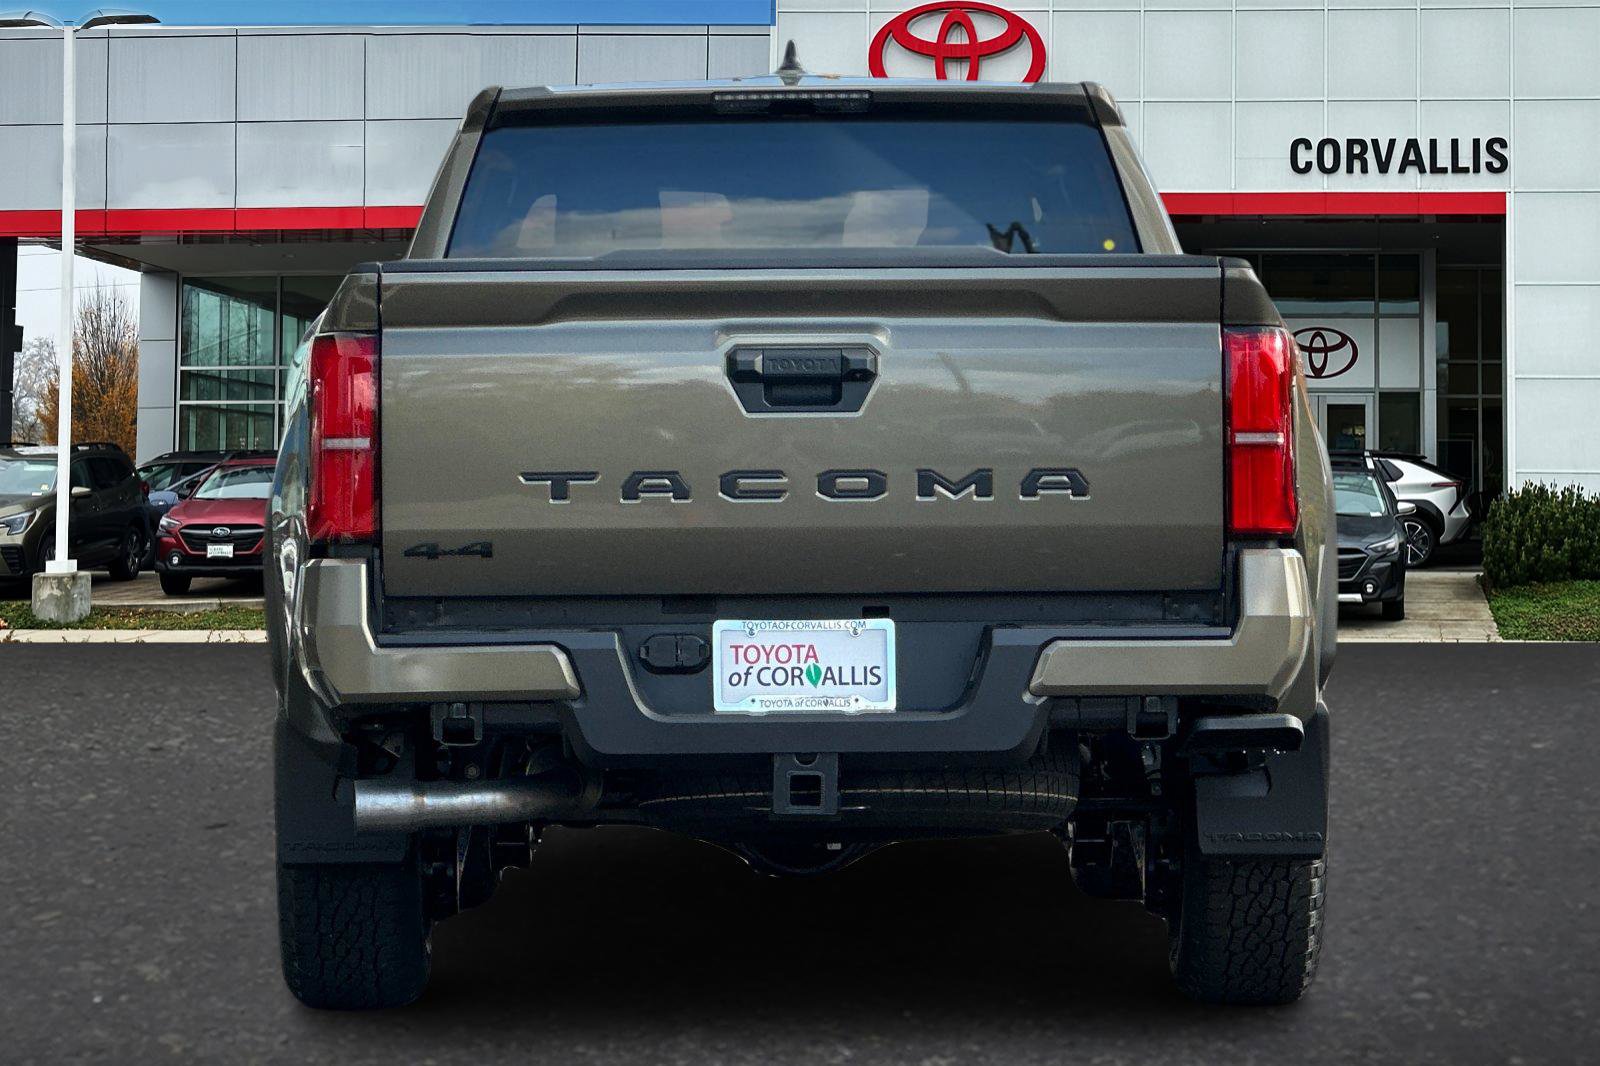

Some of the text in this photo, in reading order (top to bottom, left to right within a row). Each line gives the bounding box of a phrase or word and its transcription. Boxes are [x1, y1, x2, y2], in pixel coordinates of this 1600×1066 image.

[1290, 137, 1509, 174] CORVALLIS
[767, 358, 838, 373] TOYOTA
[518, 468, 1091, 503] TACOMA
[730, 644, 819, 664] TOYOTA
[728, 665, 753, 687] of
[760, 700, 793, 708] TOYOTA
[795, 699, 804, 708] of
